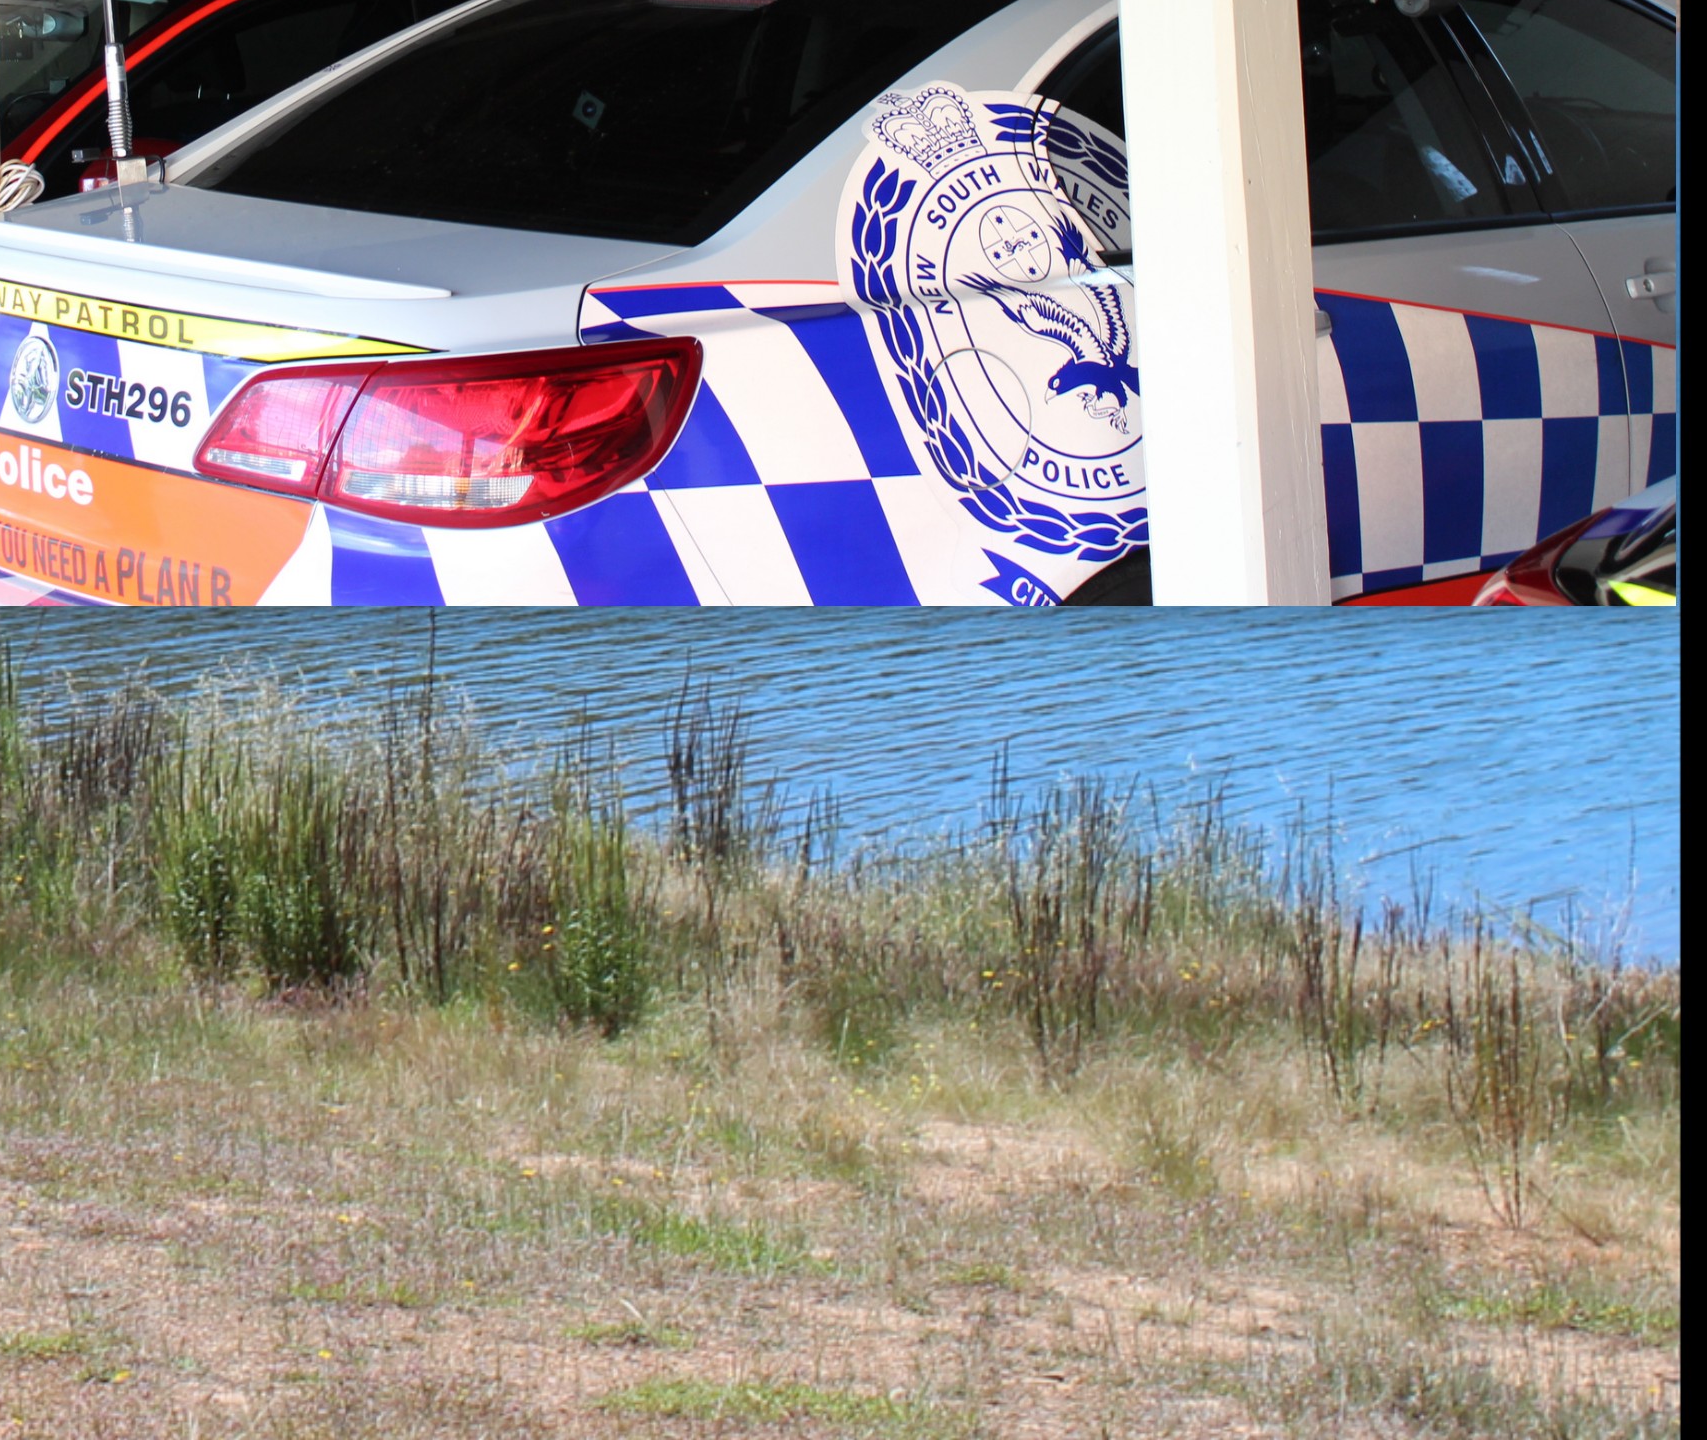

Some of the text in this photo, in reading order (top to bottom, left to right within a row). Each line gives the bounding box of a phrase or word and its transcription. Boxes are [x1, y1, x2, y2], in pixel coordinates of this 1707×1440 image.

[917, 161, 1119, 315] NEW SOUTH WALES
[56, 297, 194, 345] PATROL
[66, 368, 192, 428] STH296
[1022, 447, 1130, 489] POLICE
[33, 533, 87, 587] NEED
[94, 550, 110, 594] A
[117, 546, 201, 606] PLAN
